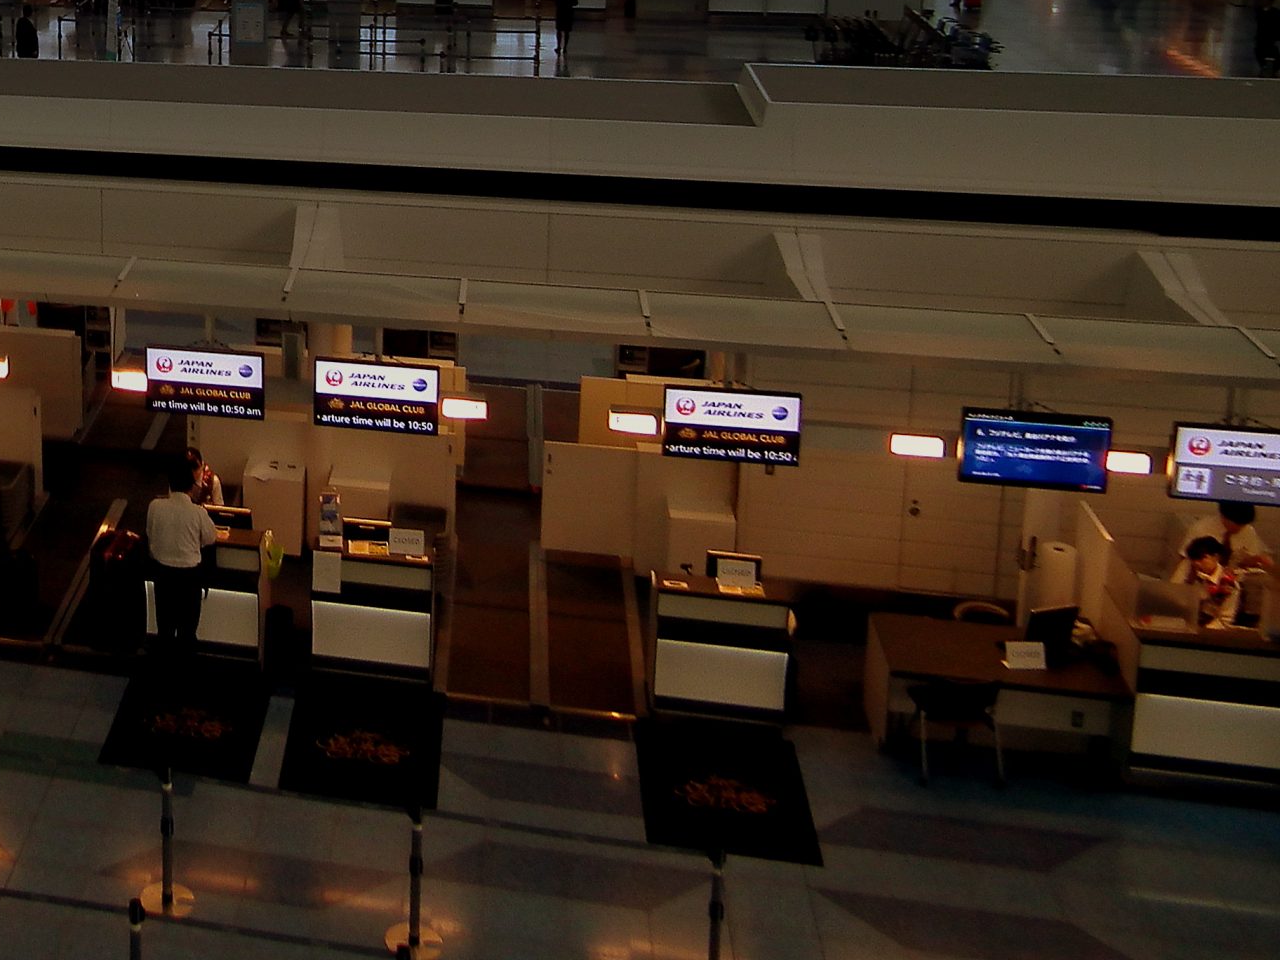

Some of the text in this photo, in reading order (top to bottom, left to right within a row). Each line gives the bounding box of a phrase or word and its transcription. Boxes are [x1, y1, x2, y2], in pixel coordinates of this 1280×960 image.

[177, 359, 213, 368] JAPAN
[180, 367, 232, 377] AIRLINES
[348, 372, 386, 381] JAPAN
[350, 381, 406, 391] AIRLINES
[179, 387, 251, 400] JAL GLOBAL CLUB
[168, 399, 188, 410] time
[189, 401, 205, 412] will
[207, 403, 219, 413] be
[221, 404, 245, 415] 10:50
[246, 408, 262, 417] am
[349, 401, 426, 415] JAL GLOBAL CLUB
[701, 400, 743, 409] JAPAN
[703, 409, 765, 420] AIRLINES
[352, 416, 373, 426] time
[374, 417, 391, 428] will
[392, 419, 405, 430] be
[408, 421, 434, 432] 10:50
[701, 429, 787, 445] JAL GLOBAL CLUB
[1218, 440, 1266, 449] JAPAN
[701, 446, 726, 457] time
[726, 447, 746, 459] will
[747, 449, 762, 460] be
[763, 450, 792, 462] 10:50
